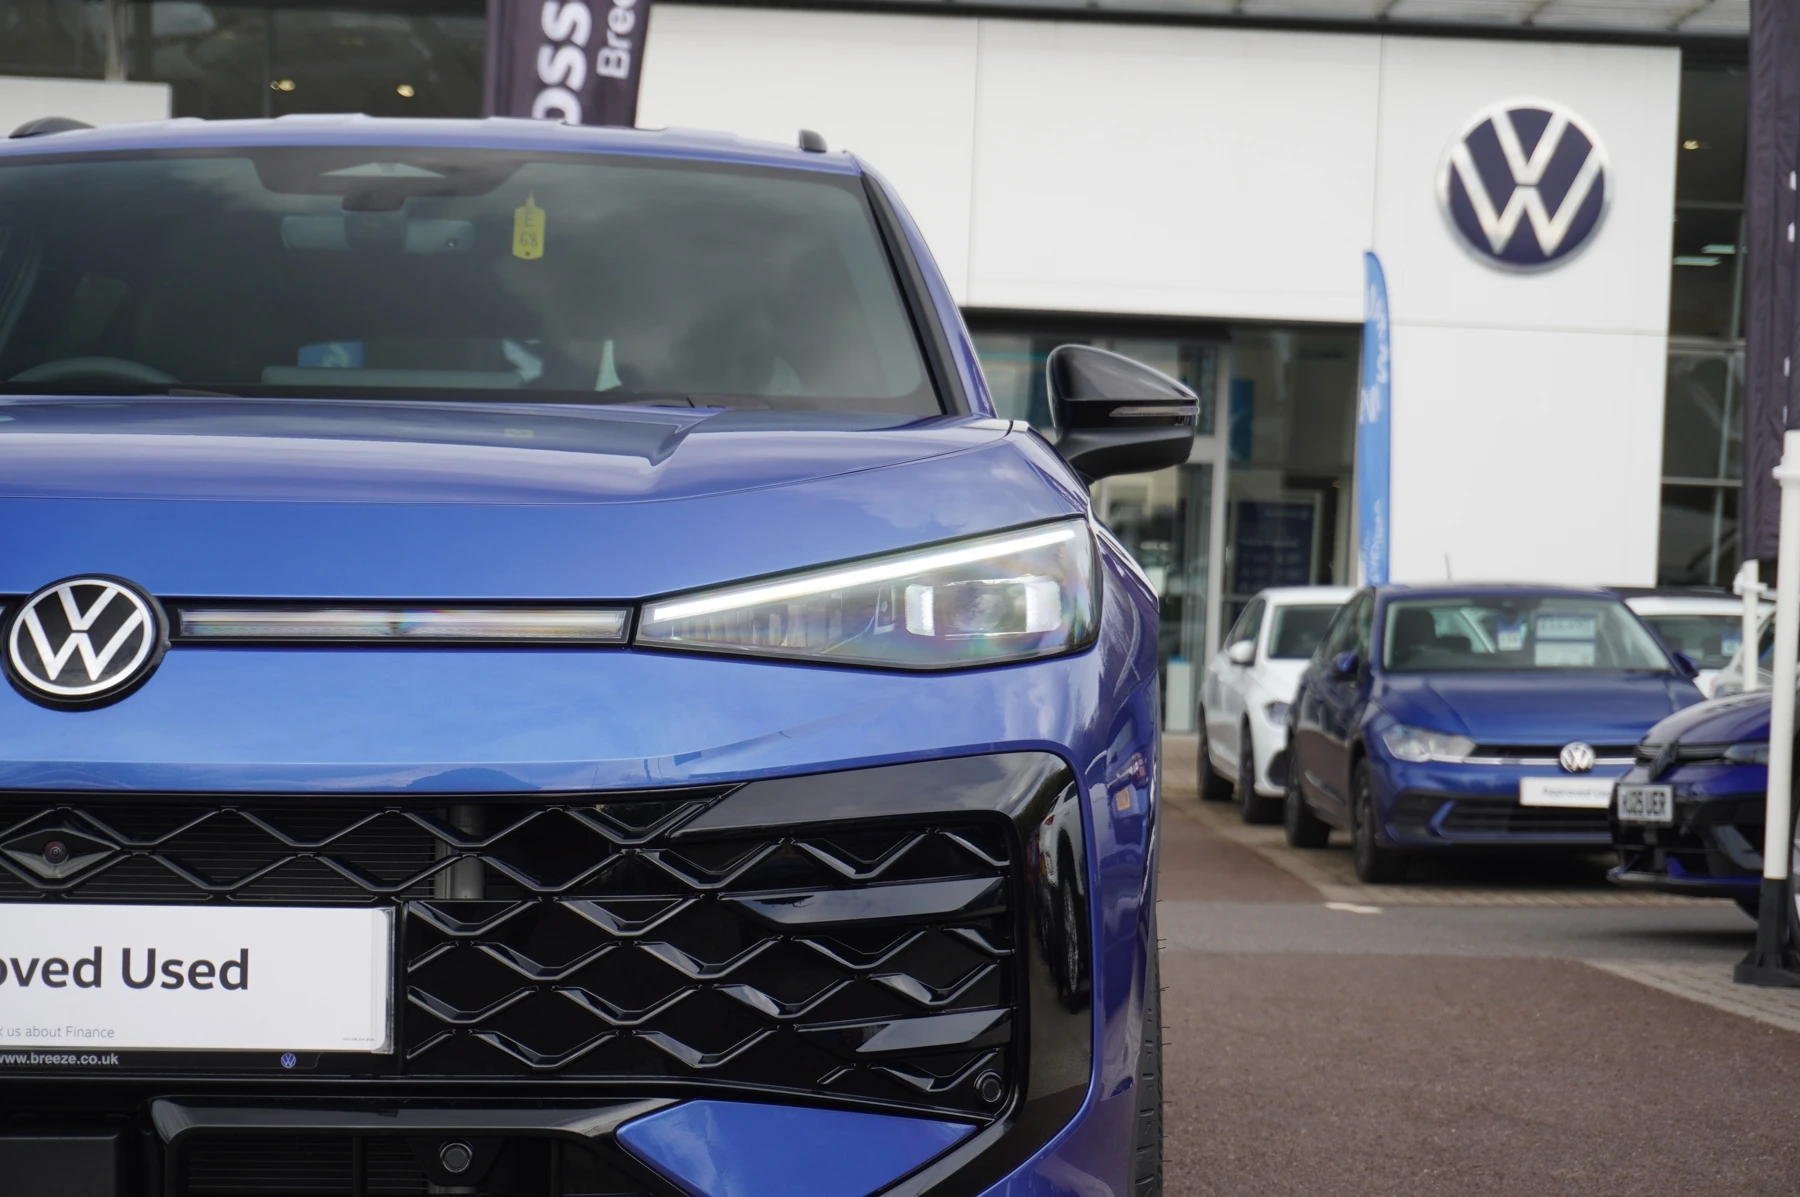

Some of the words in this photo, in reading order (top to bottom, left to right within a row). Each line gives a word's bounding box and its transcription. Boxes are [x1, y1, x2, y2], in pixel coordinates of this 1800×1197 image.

[596, 0, 638, 80] Bre
[1445, 100, 1608, 264] VW
[17, 582, 149, 688] VW
[0, 946, 102, 989] ved
[121, 947, 249, 990] Used
[7, 1027, 21, 1037] us
[25, 1025, 62, 1038] about
[66, 1026, 115, 1038] Finance
